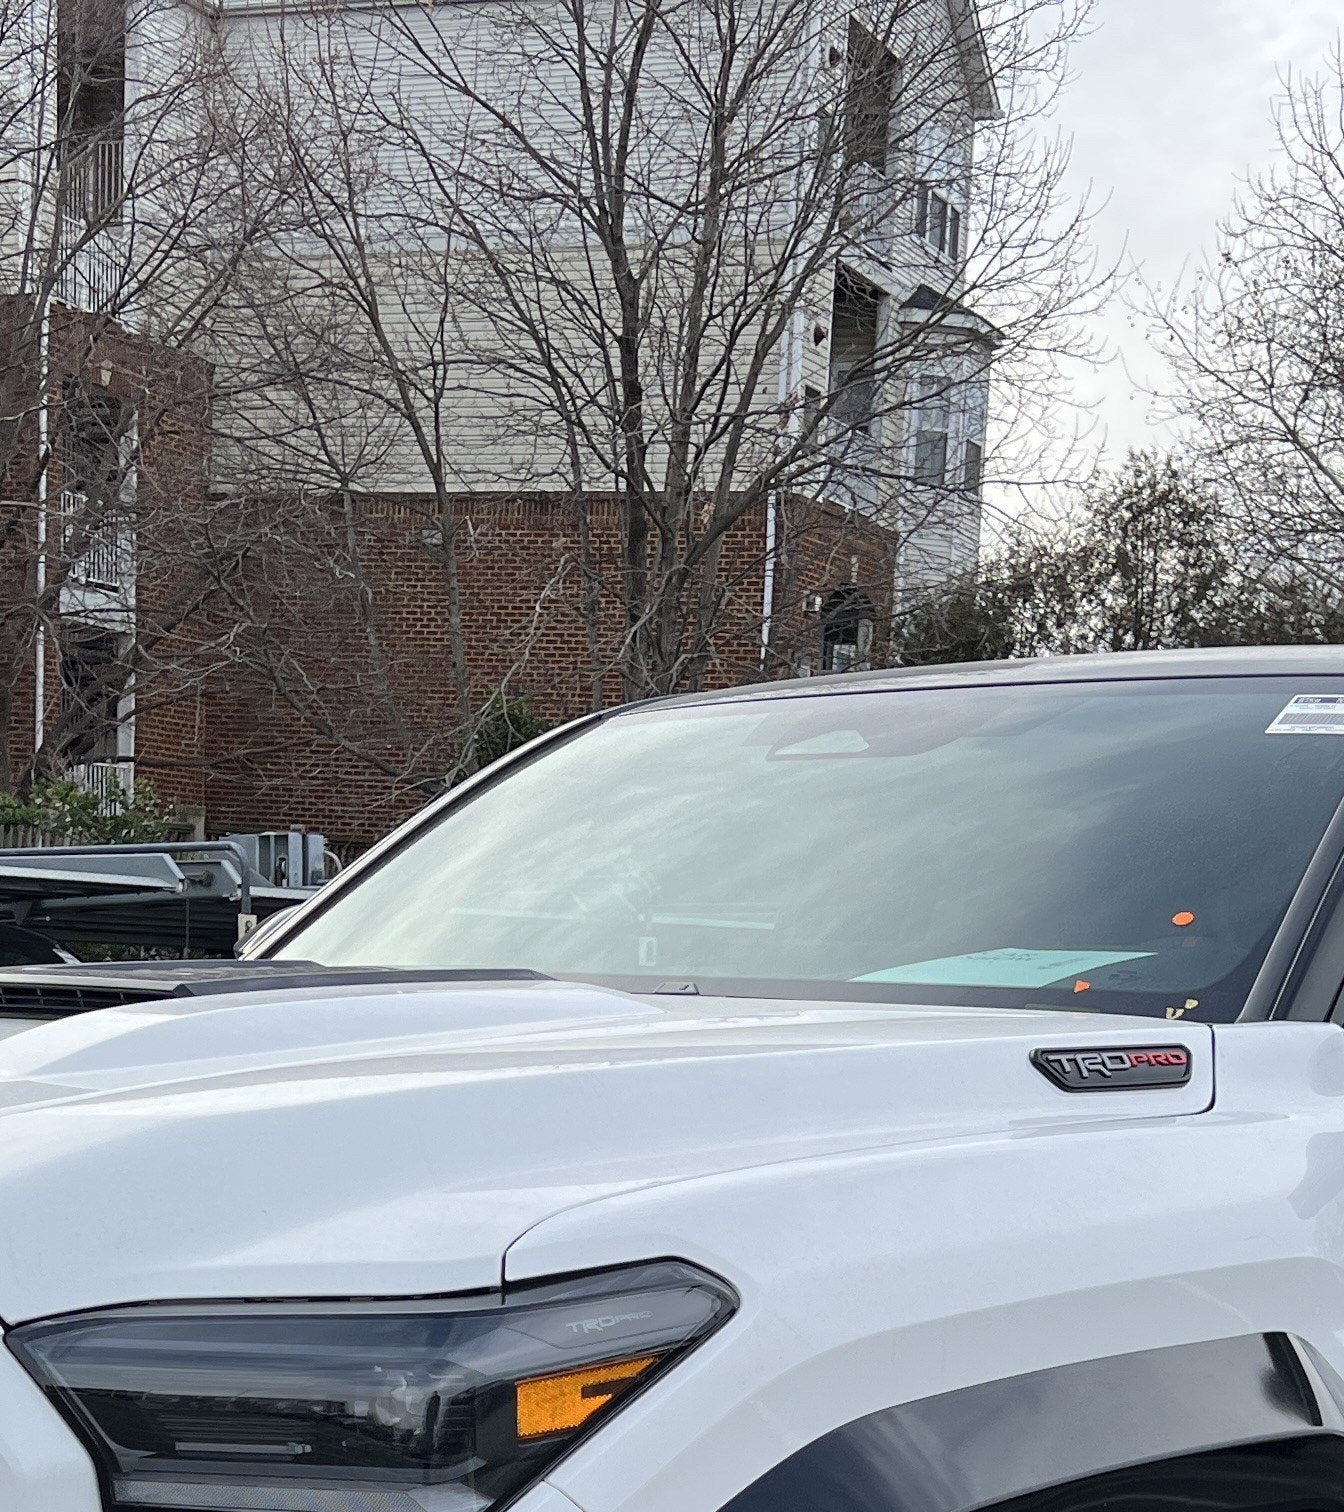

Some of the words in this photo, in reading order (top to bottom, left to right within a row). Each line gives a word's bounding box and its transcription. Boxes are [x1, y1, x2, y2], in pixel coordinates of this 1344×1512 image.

[1045, 1053, 1131, 1078] TRD
[1129, 1053, 1188, 1069] PRO
[566, 1316, 616, 1333] TRD
